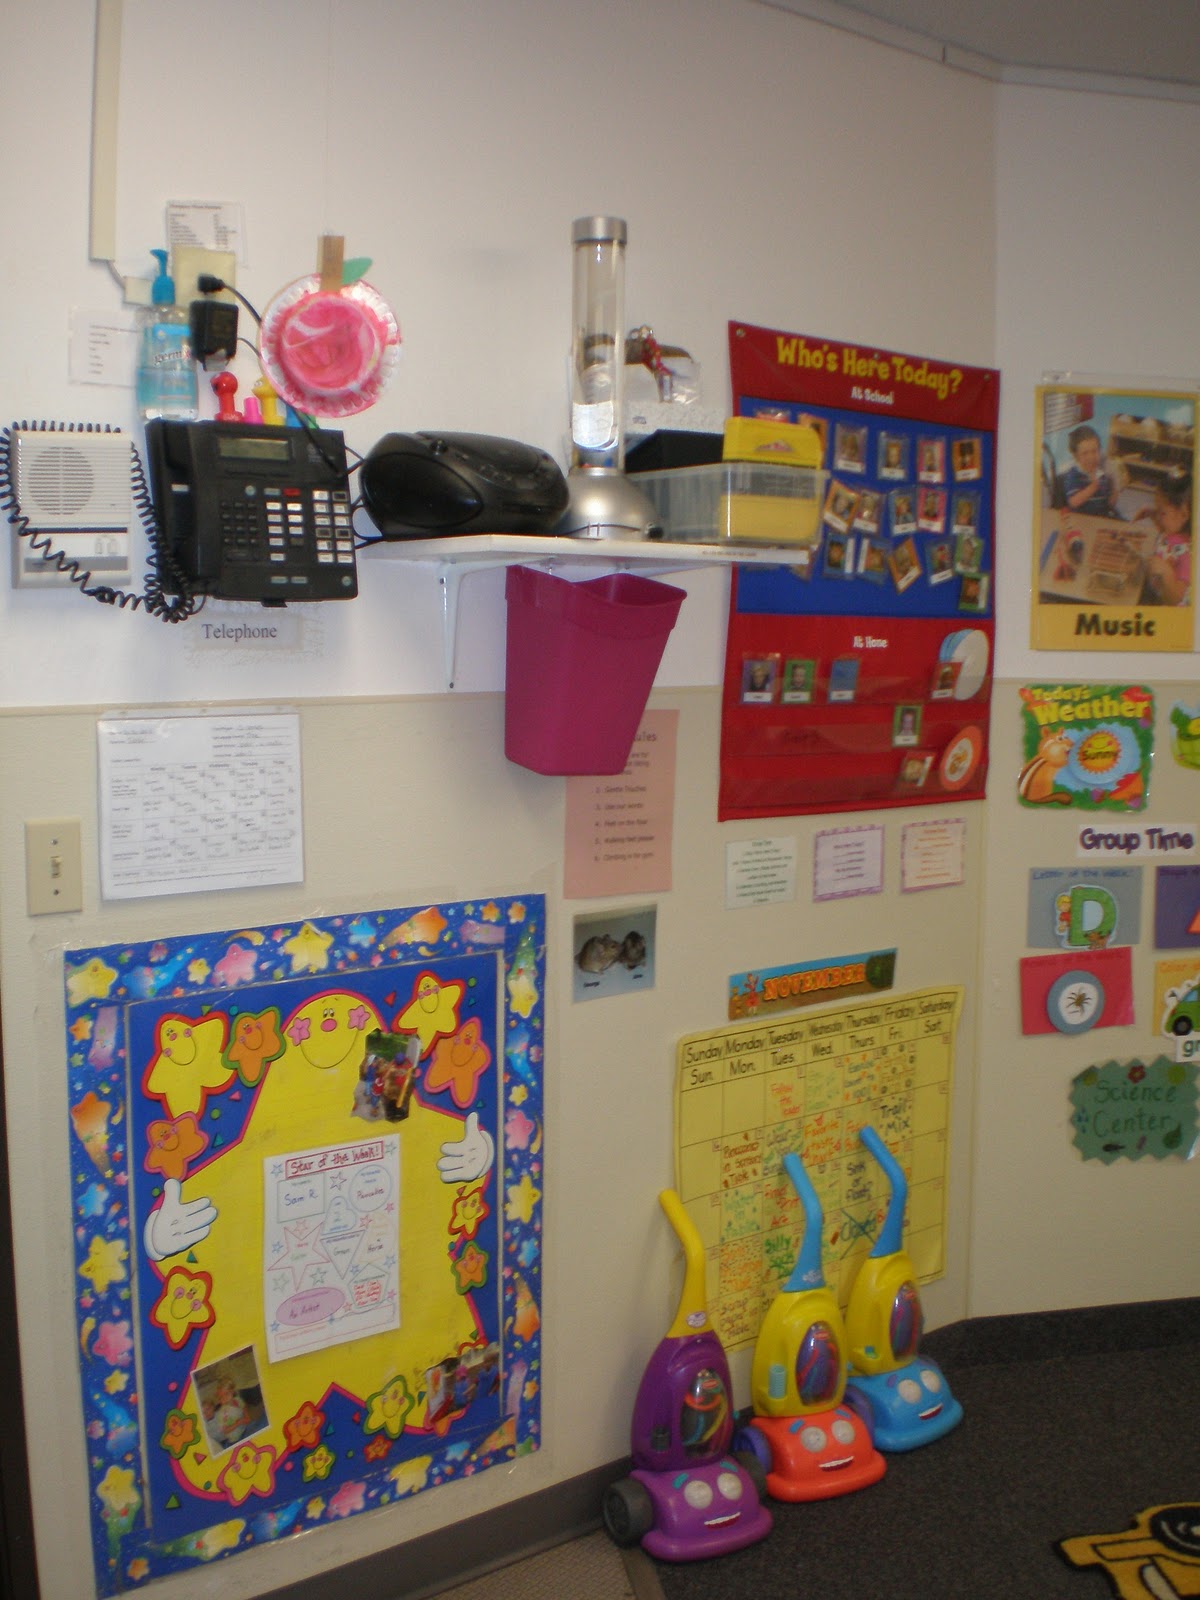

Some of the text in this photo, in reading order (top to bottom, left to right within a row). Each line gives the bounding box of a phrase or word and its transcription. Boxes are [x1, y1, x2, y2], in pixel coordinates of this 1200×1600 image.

[776, 336, 964, 400] Who's Here Today?
[851, 386, 894, 405] At School
[202, 623, 278, 642] Telephone
[1074, 612, 1157, 636] Music
[853, 636, 888, 648] At Home
[1031, 685, 1092, 701] Today's
[1033, 695, 1150, 726] Weather
[1084, 748, 1119, 761] Sunny
[1079, 827, 1193, 855] Group Time
[1069, 886, 1117, 947] D
[763, 962, 866, 1001] NOVEMBER
[685, 1000, 953, 1064] Sunday Monday Tuesday Wednesday Thursday Friday Saturday
[1094, 1080, 1177, 1104] Science
[1093, 1107, 1172, 1138] Center
[290, 1160, 314, 1175] Star
[317, 1154, 329, 1168] of
[331, 1150, 350, 1165] the
[284, 1193, 305, 1206] Sam
